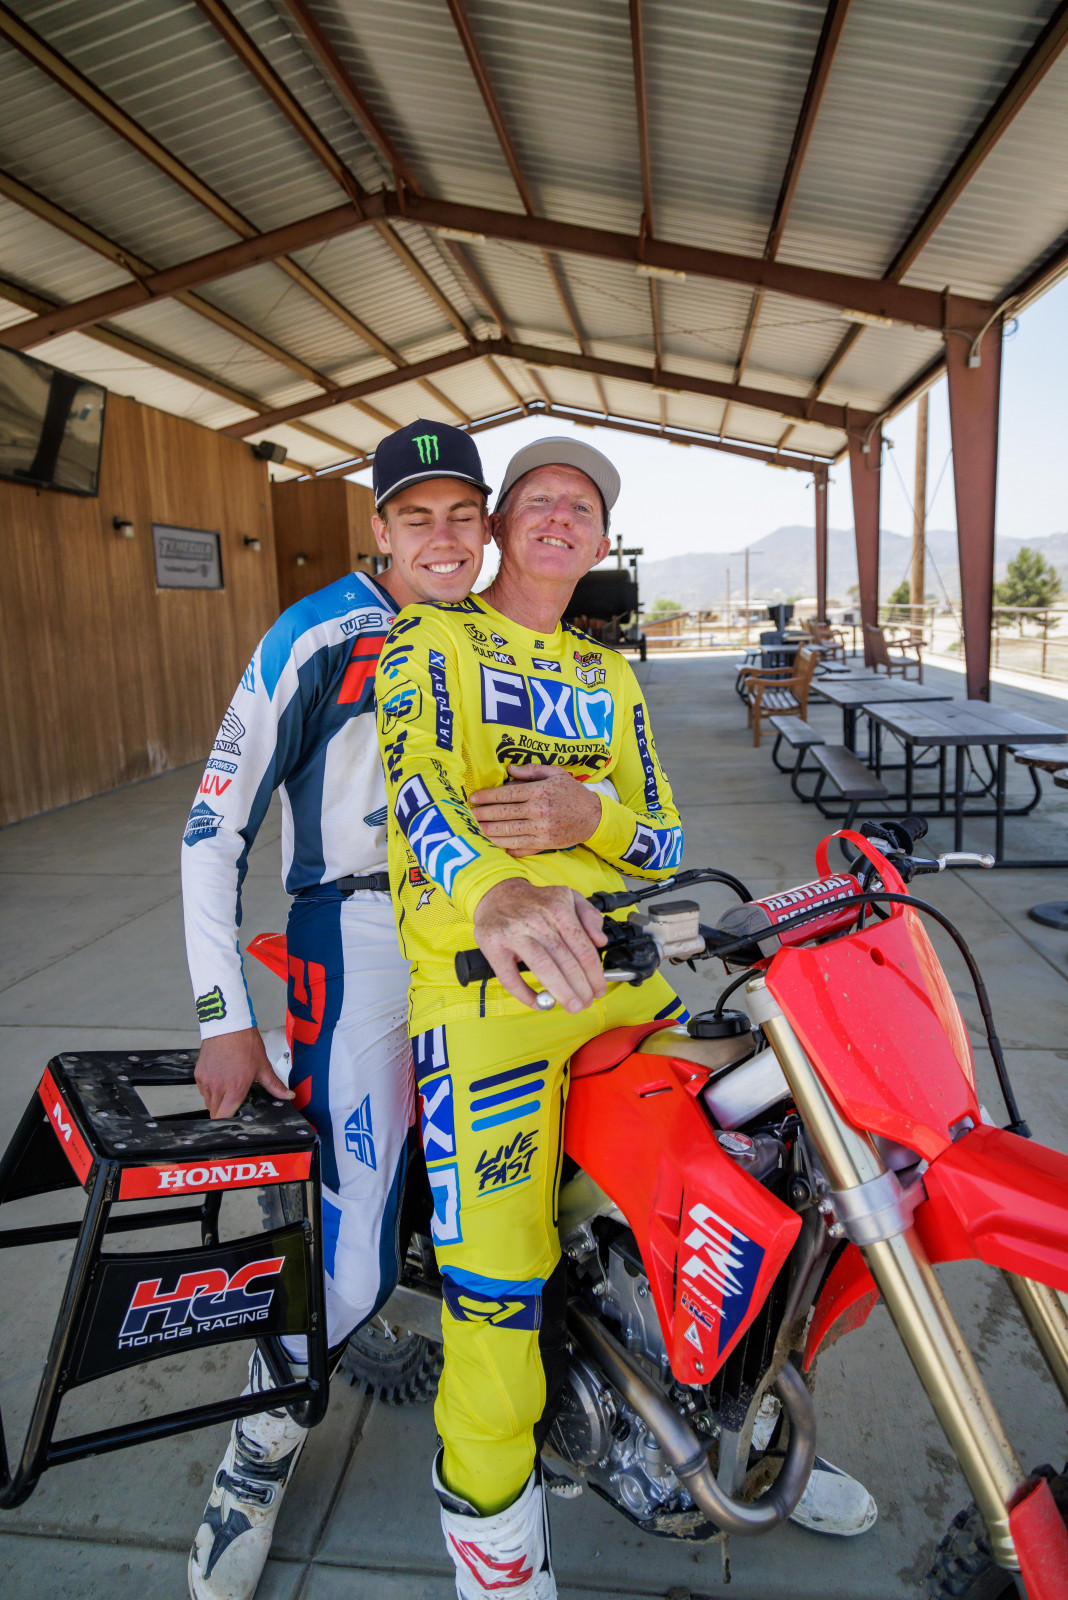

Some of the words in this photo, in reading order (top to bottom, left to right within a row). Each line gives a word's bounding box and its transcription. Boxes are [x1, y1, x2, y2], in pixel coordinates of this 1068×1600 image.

[340, 613, 383, 636] WPS
[518, 734, 551, 752] ROCKY
[634, 707, 657, 799] FACTORY
[763, 876, 852, 912] RENTHAL
[475, 1129, 539, 1174] LIVE
[478, 1147, 538, 1191] FAST
[158, 1161, 279, 1189] HONDA
[118, 1256, 286, 1337] HRC
[118, 1330, 193, 1350] Honda
[197, 1308, 269, 1333] RACING
